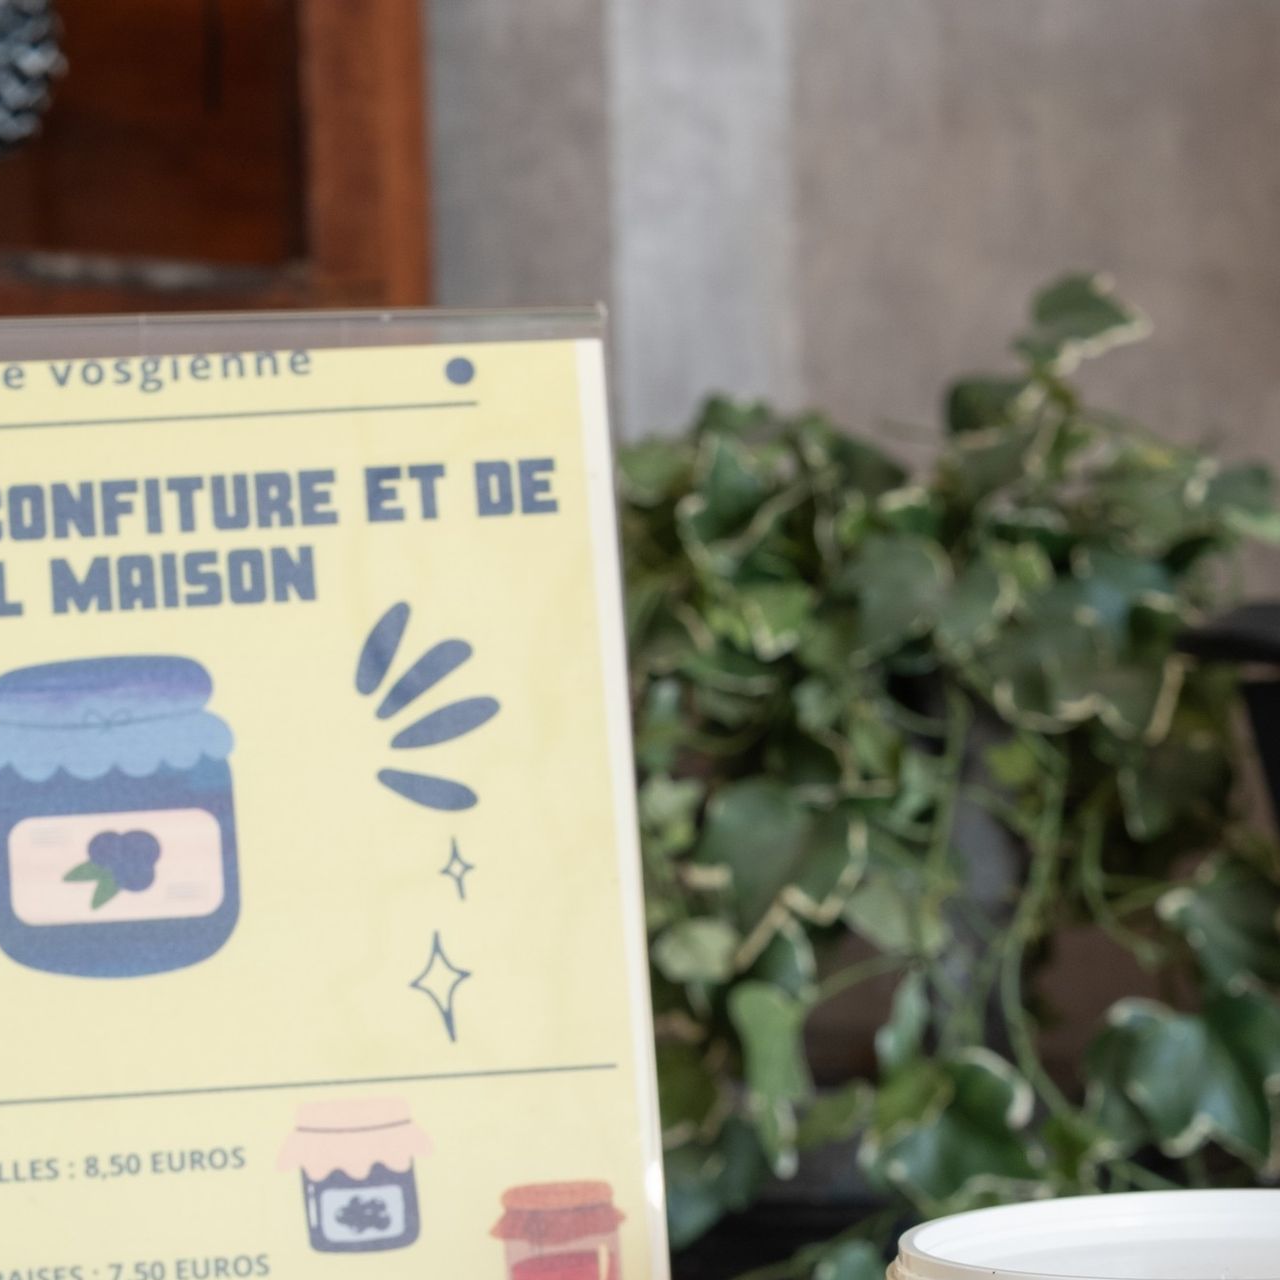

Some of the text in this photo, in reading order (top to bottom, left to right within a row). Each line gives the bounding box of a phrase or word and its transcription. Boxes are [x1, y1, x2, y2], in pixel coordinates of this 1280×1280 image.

[364, 464, 445, 523] ET
[474, 458, 558, 517] DE
[50, 545, 316, 616] MAISON
[84, 1153, 142, 1181] 8,50
[150, 1147, 247, 1175] EUROS
